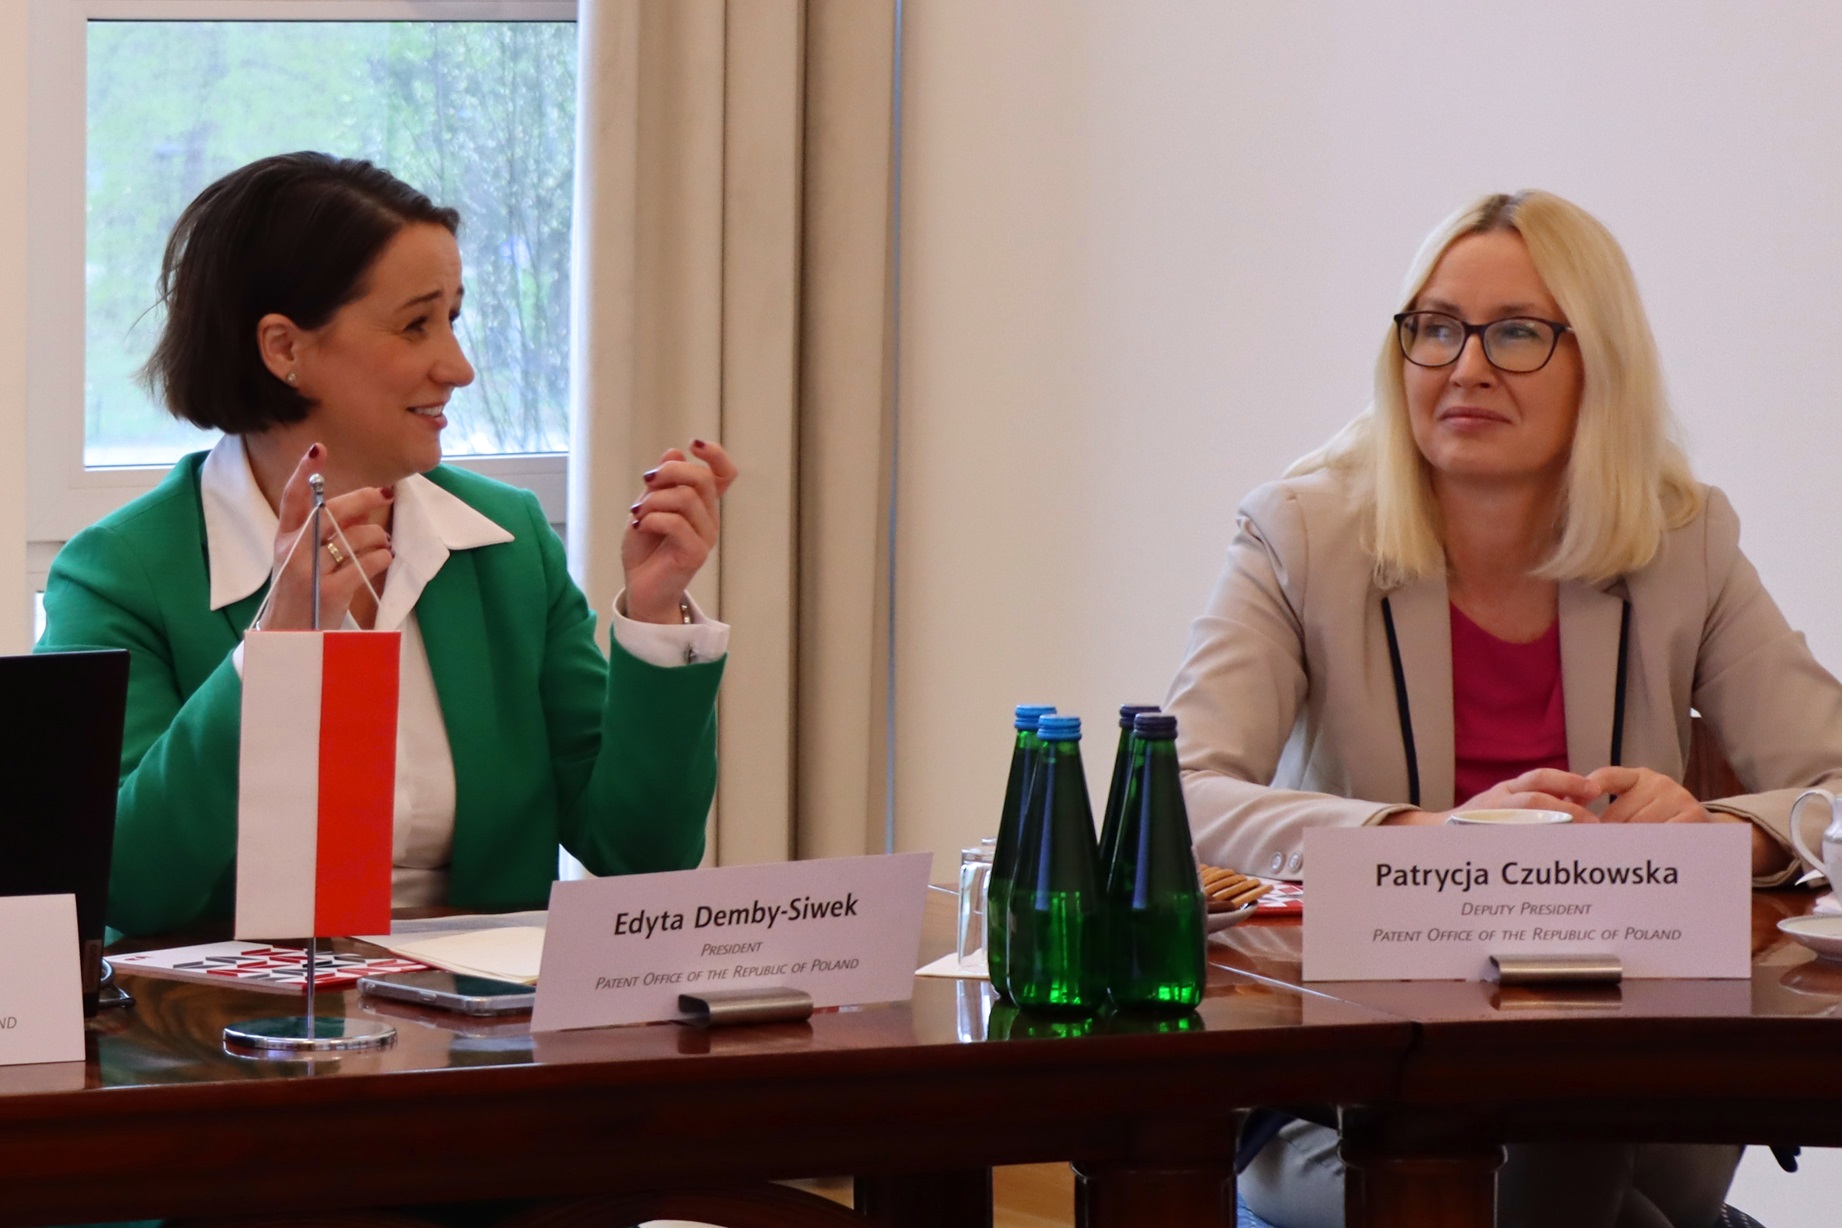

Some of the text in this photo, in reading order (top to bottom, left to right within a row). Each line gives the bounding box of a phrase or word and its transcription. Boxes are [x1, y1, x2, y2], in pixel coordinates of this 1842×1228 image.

[1375, 859, 1679, 893] Patrycja Czubkowska
[614, 891, 860, 940] Edyta Demby-Siwek
[1460, 901, 1593, 917] DEPUTY PRESIDENT
[1372, 928, 1423, 943] PATENT
[1426, 927, 1474, 942] OFFICE
[1532, 926, 1597, 941] REPUBLIC
[1623, 926, 1683, 941] POLAND
[700, 941, 764, 957] PRESIDENT
[595, 974, 640, 991] PATENT
[642, 971, 683, 987] OFFICE
[733, 963, 788, 979] REPUBLIC
[810, 958, 860, 973] POLAND
